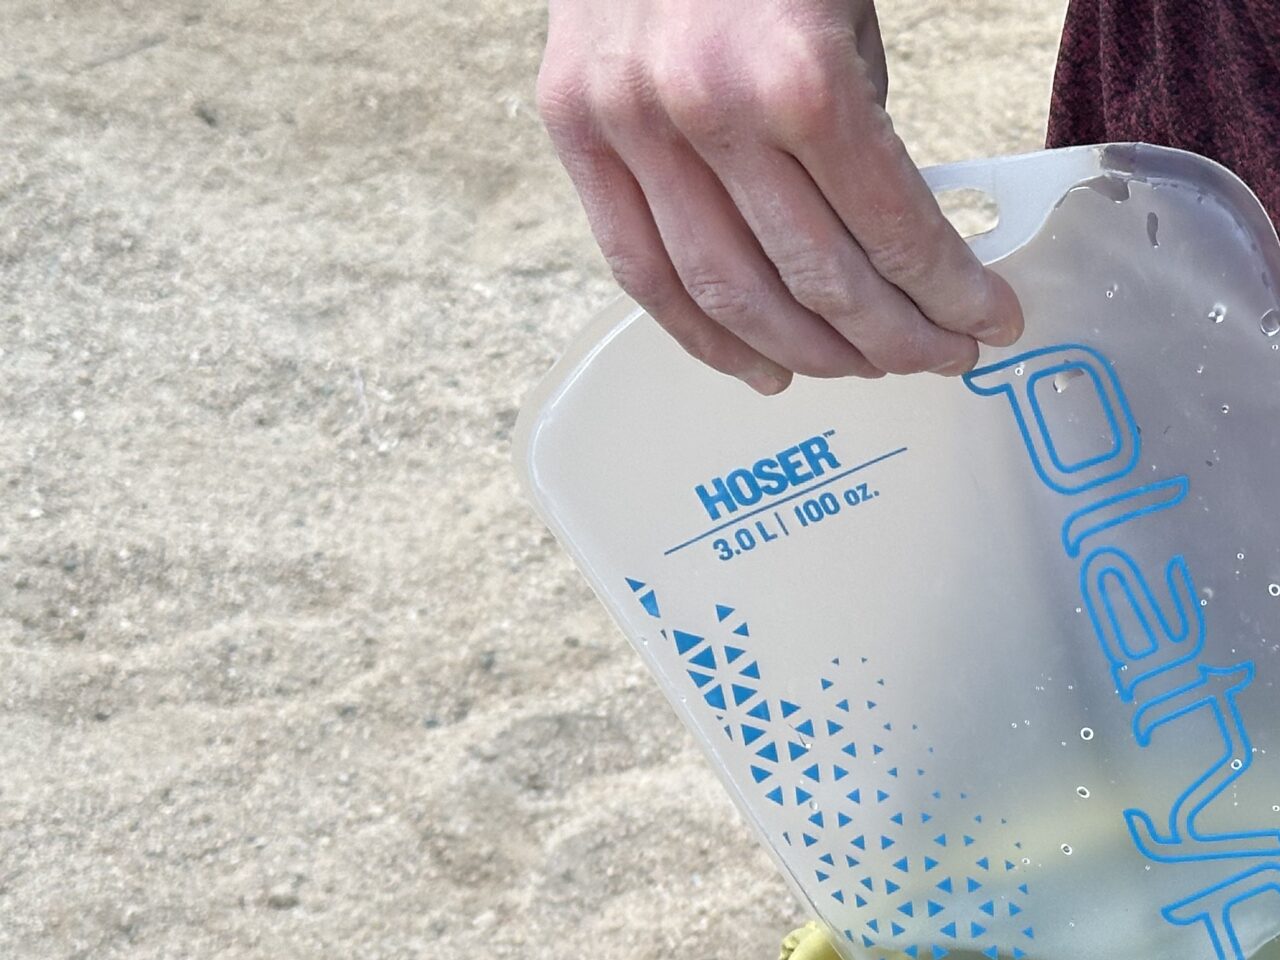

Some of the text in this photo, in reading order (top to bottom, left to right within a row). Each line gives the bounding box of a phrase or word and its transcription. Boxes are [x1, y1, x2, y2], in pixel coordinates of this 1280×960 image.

[713, 528, 756, 561] 3.0
[794, 492, 841, 527] 100
[843, 482, 880, 507] oz.
